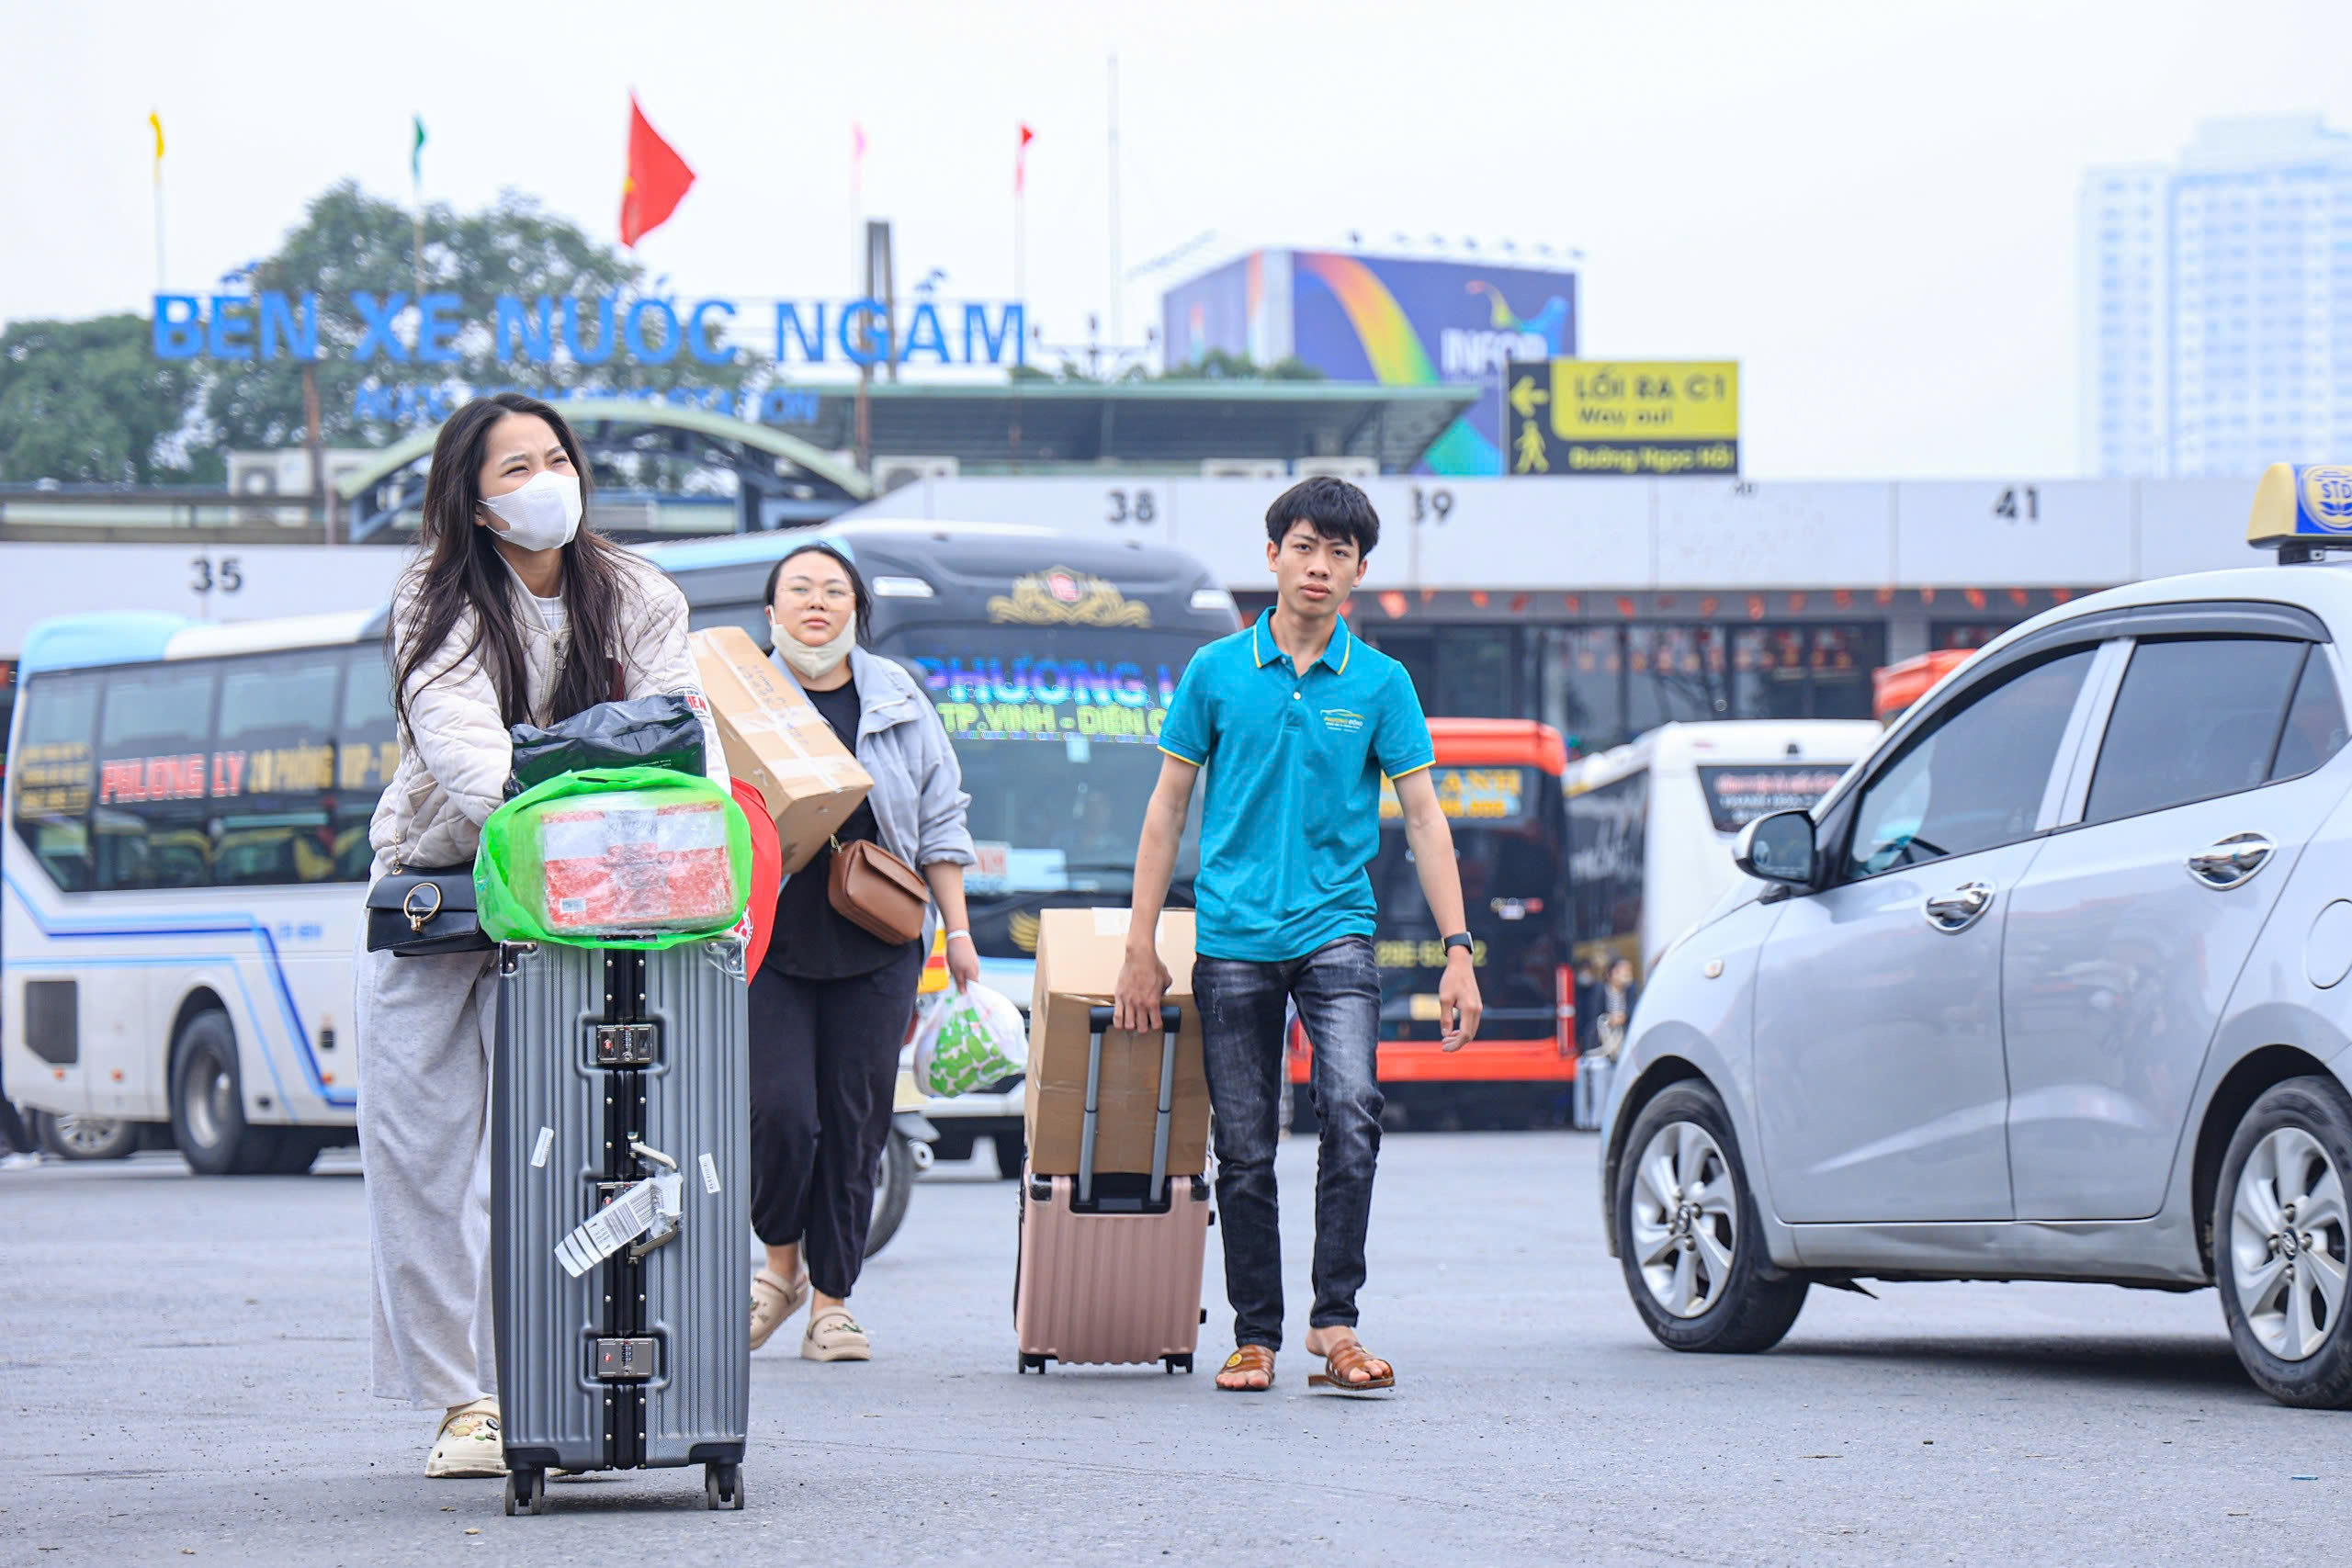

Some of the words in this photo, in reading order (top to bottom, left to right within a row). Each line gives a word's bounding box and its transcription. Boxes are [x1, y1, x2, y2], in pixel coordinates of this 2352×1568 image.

[350, 290, 463, 362] XE
[1635, 375, 1677, 400] RA
[1578, 407, 1629, 427] Way
[1106, 489, 1156, 527] 38
[1993, 486, 2041, 523] 41
[189, 556, 243, 594] 35
